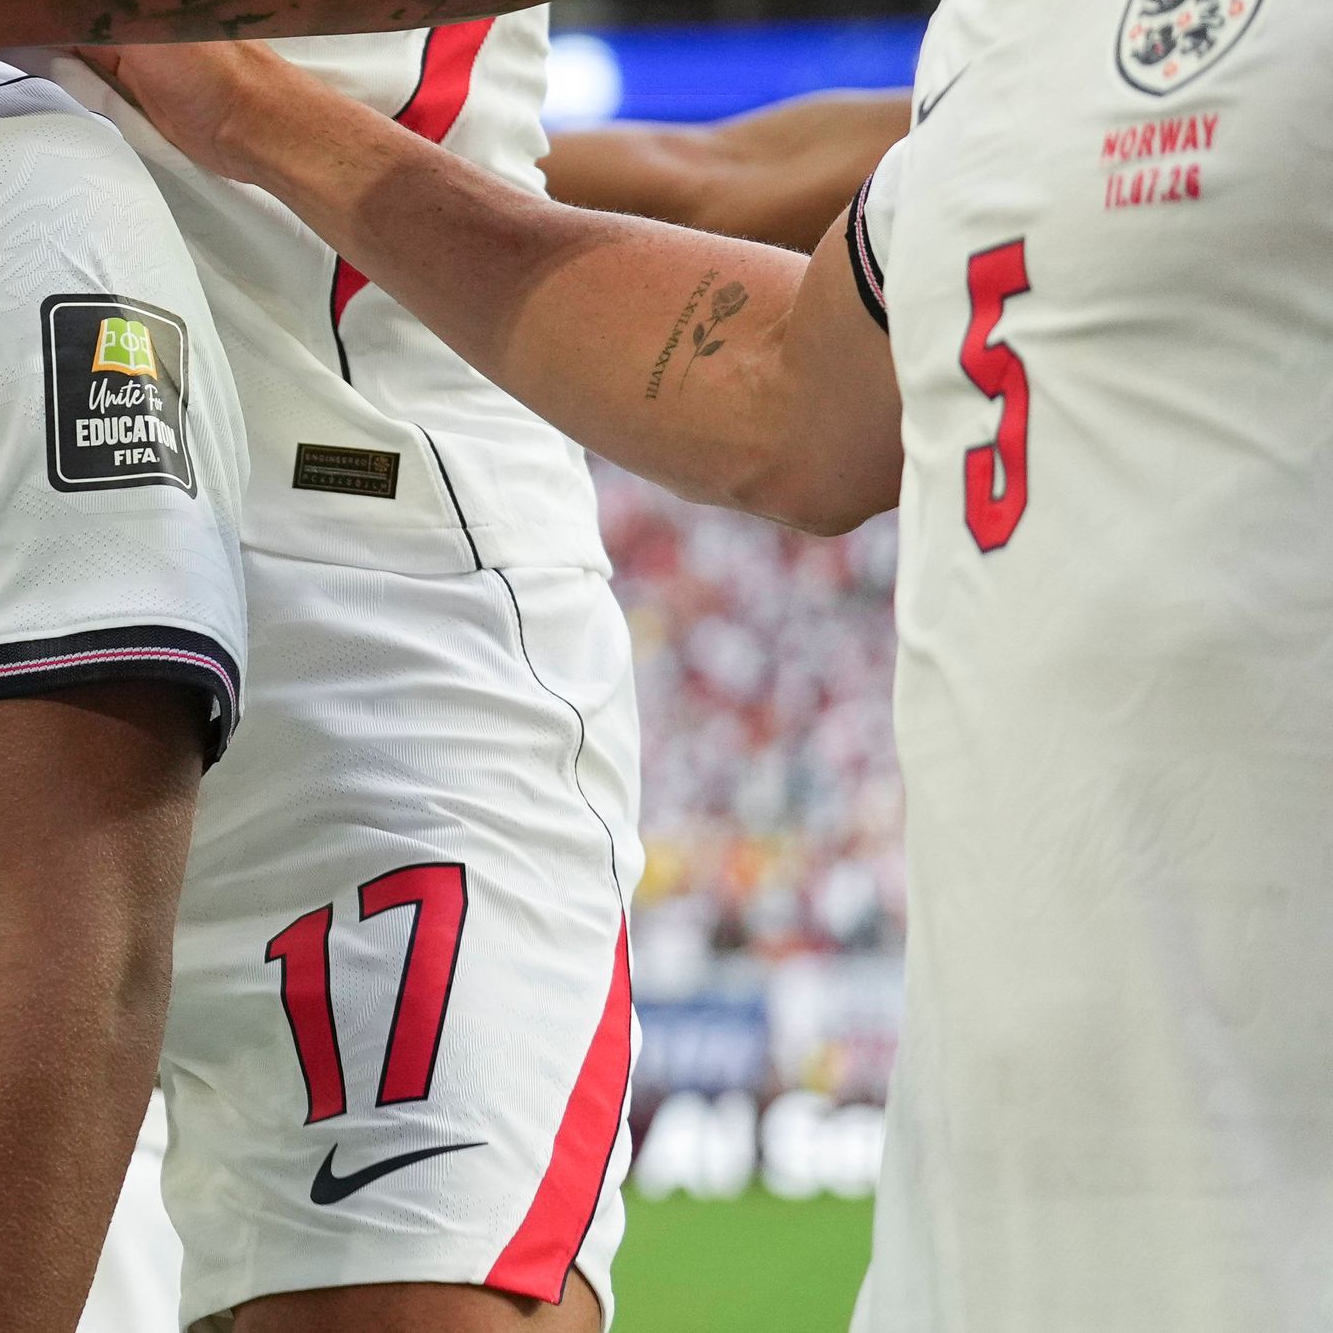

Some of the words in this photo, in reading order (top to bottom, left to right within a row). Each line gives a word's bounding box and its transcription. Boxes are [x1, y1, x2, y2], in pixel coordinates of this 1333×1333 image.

[1101, 112, 1220, 161] NORWAY
[88, 377, 145, 414] Unite
[144, 383, 164, 412] For
[959, 235, 1032, 555] 5
[75, 415, 179, 454] EDUCATION
[113, 447, 160, 467] FIFA
[264, 862, 469, 1127] 17
